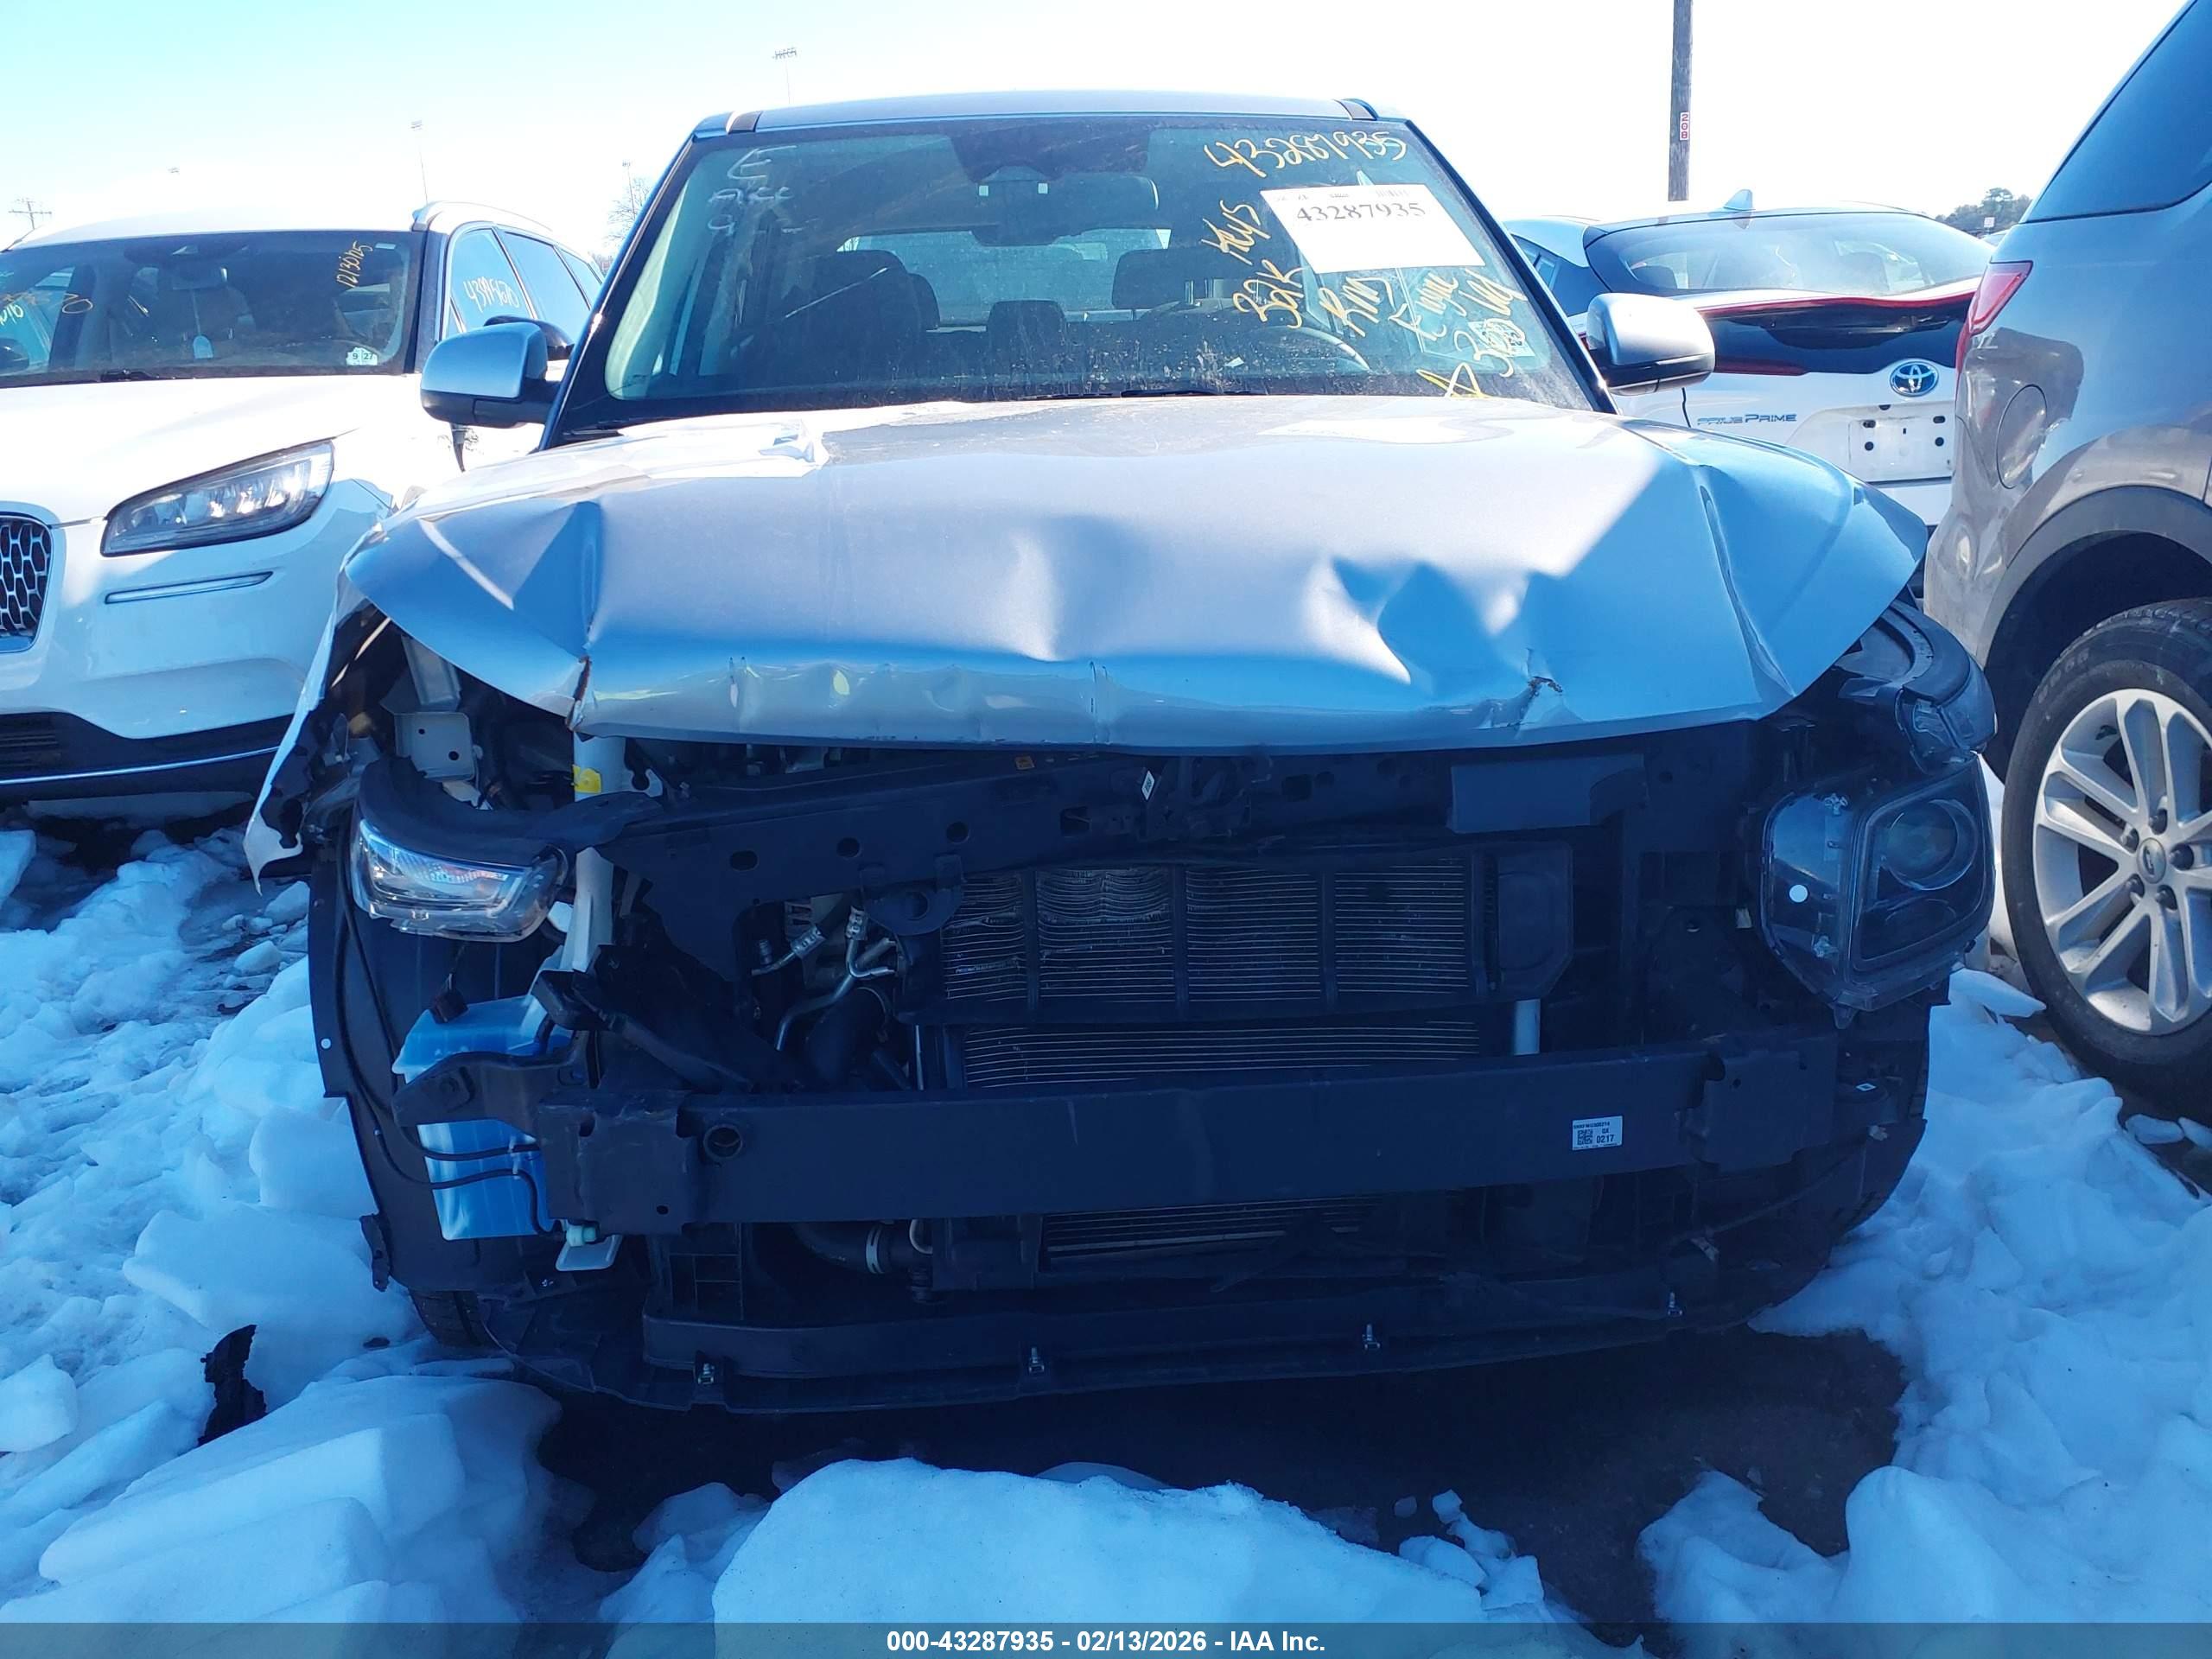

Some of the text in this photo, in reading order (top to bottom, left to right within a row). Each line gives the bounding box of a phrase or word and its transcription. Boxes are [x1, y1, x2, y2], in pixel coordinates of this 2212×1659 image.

[1681, 113, 1689, 139] 208
[1297, 202, 1426, 221] 43287935
[1745, 414, 1797, 423] PRIME
[1596, 1135, 1615, 1144] 0217
